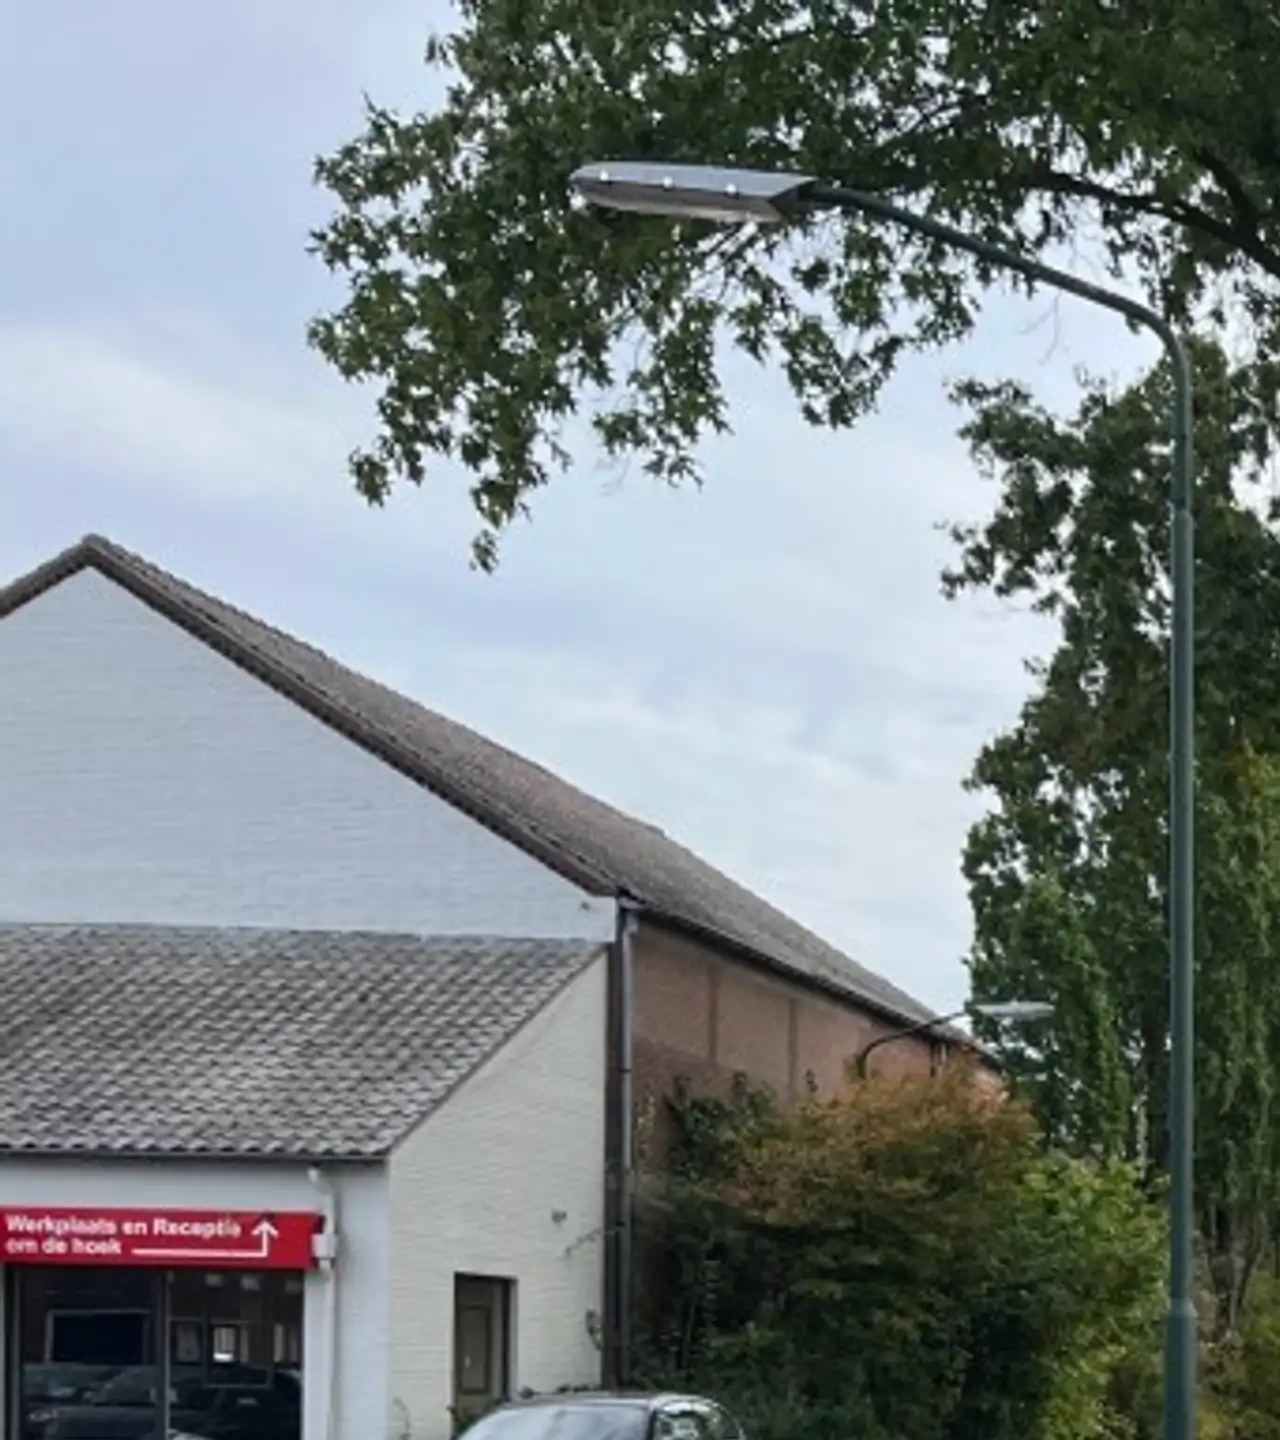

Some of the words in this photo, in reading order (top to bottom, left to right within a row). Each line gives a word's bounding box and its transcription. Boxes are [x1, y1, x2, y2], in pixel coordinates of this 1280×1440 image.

[6, 1213, 118, 1236] Werkplaats
[121, 1220, 147, 1234] en
[152, 1217, 242, 1238] Receptie
[6, 1238, 38, 1254] om
[41, 1237, 69, 1254] de
[71, 1238, 122, 1255] hoek
